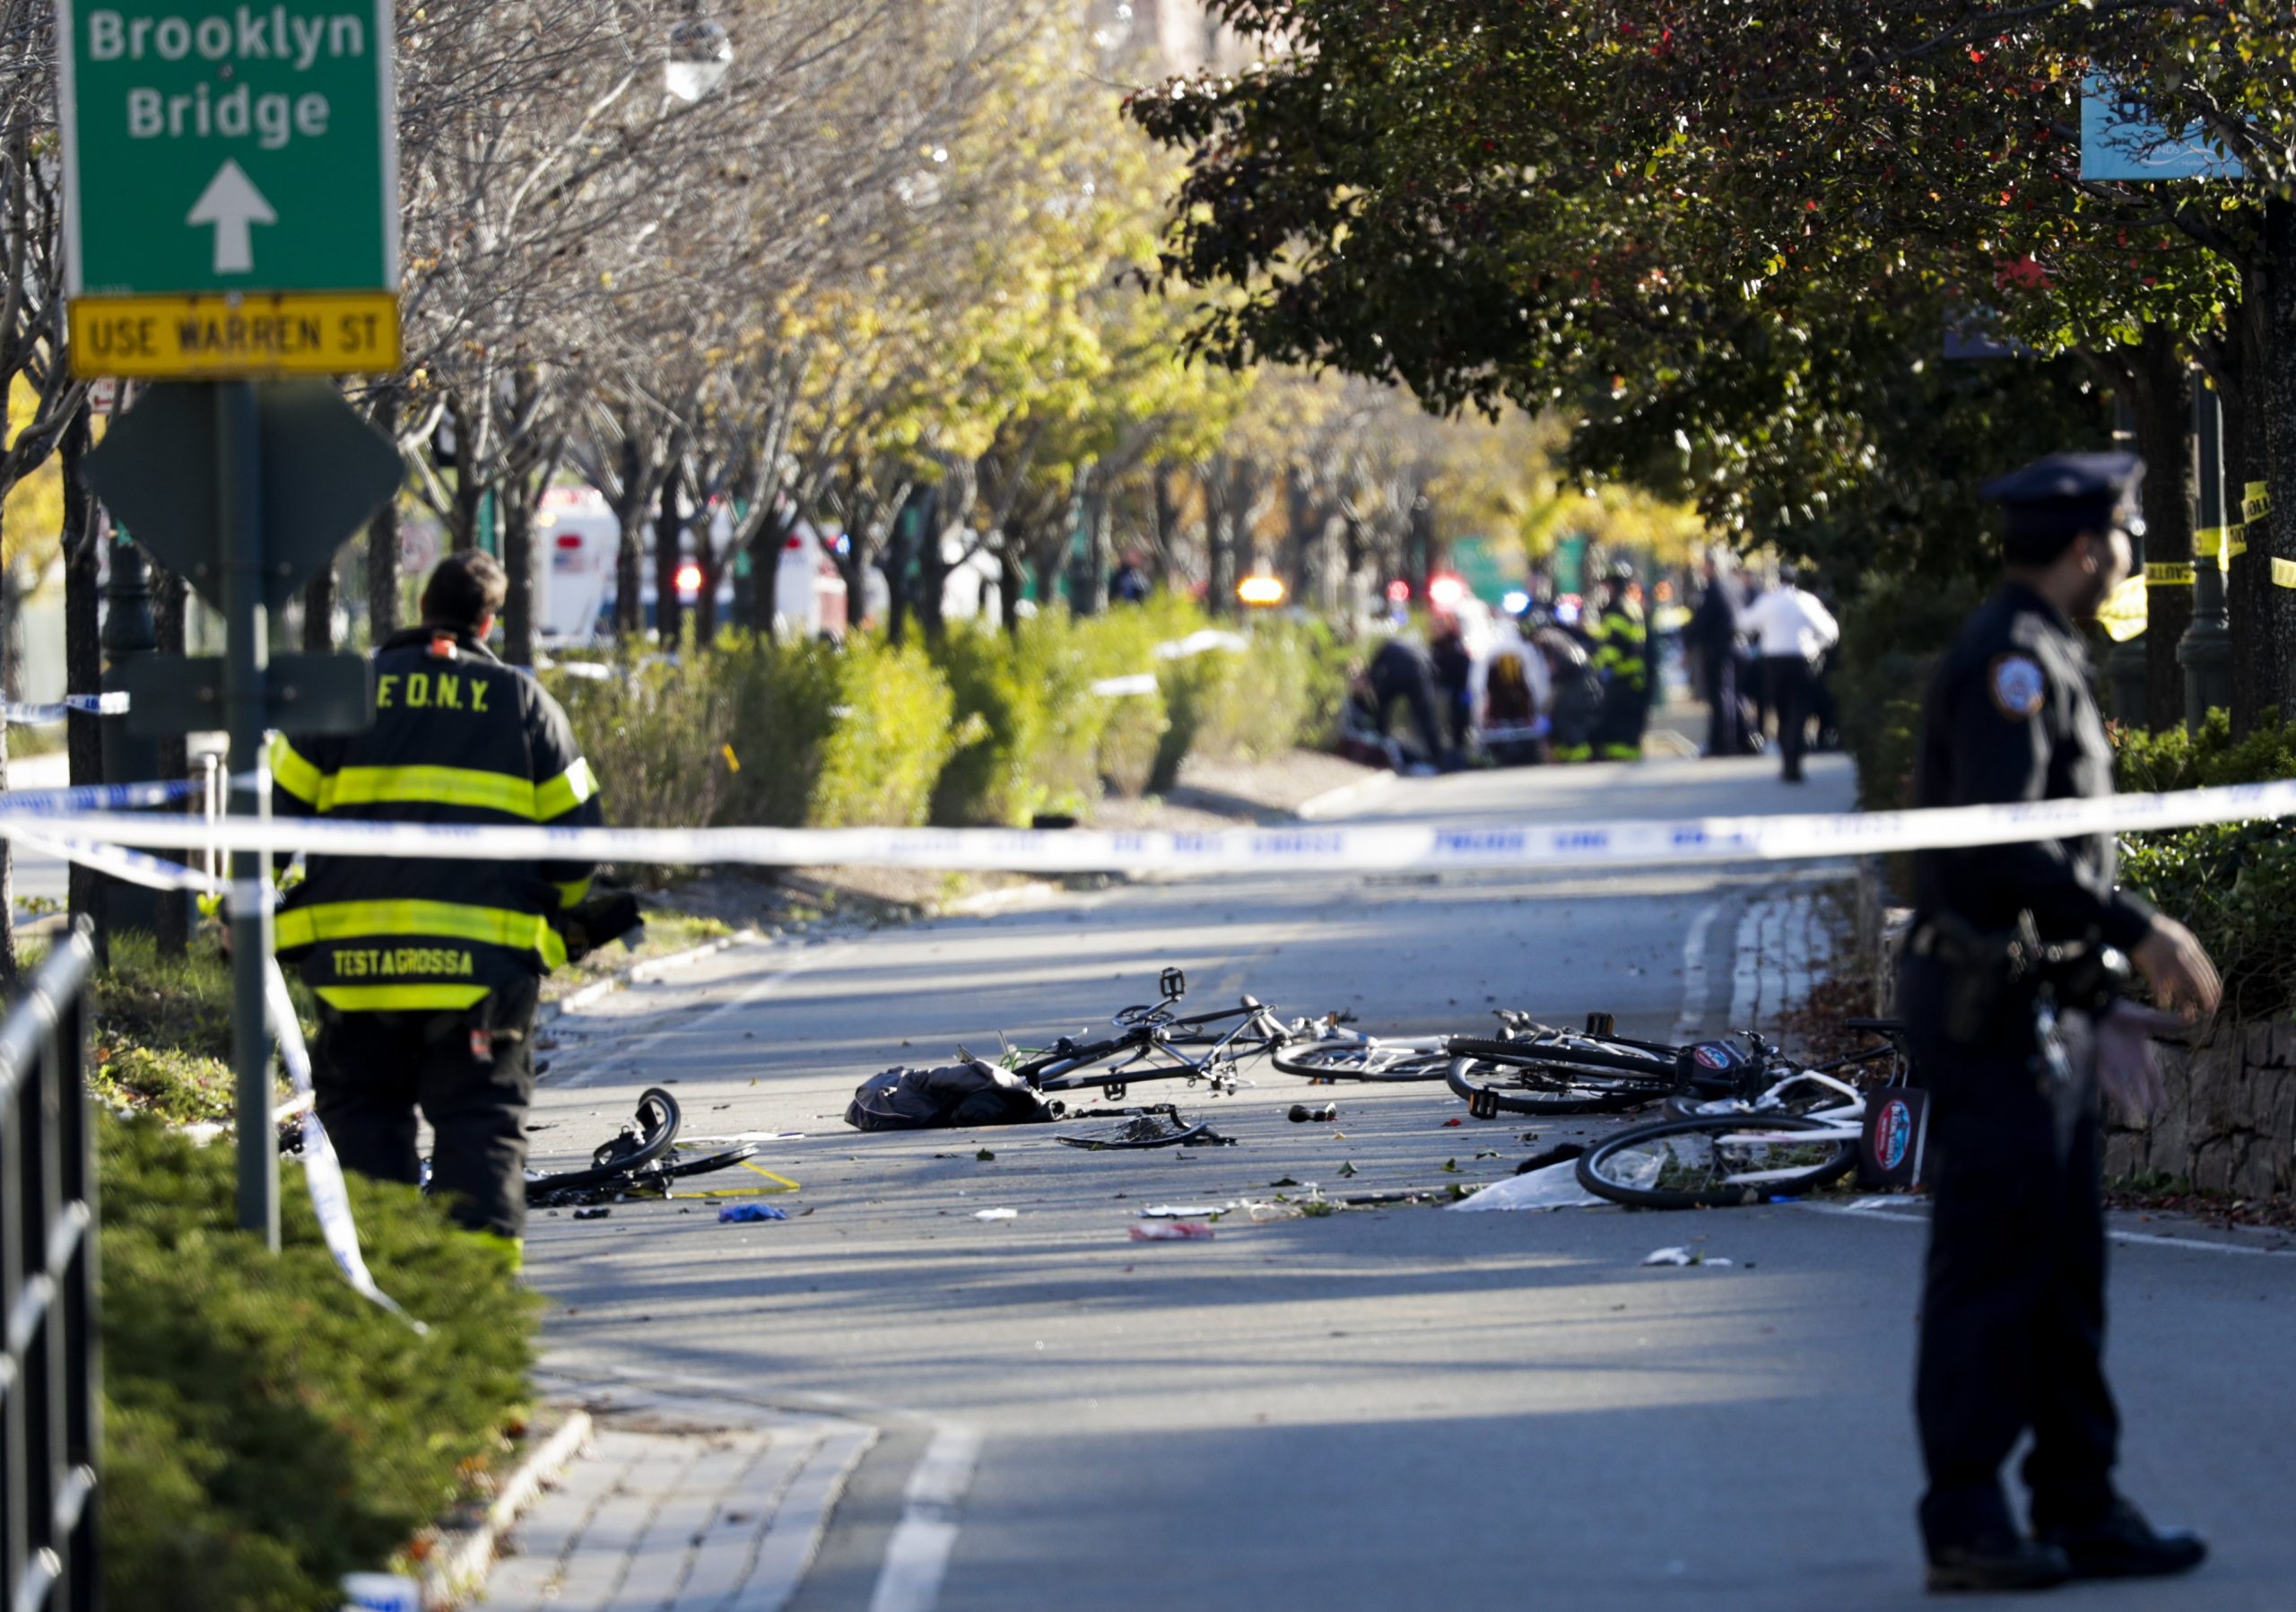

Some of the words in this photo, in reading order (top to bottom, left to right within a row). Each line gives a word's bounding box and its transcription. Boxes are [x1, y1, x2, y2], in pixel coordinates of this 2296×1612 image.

[90, 4, 364, 72] Brooklyn
[127, 82, 330, 149] Bridge
[91, 317, 158, 358] USE
[176, 314, 322, 354] WARREN
[339, 314, 379, 354] ST
[332, 947, 474, 977] TESTAGROSSA
